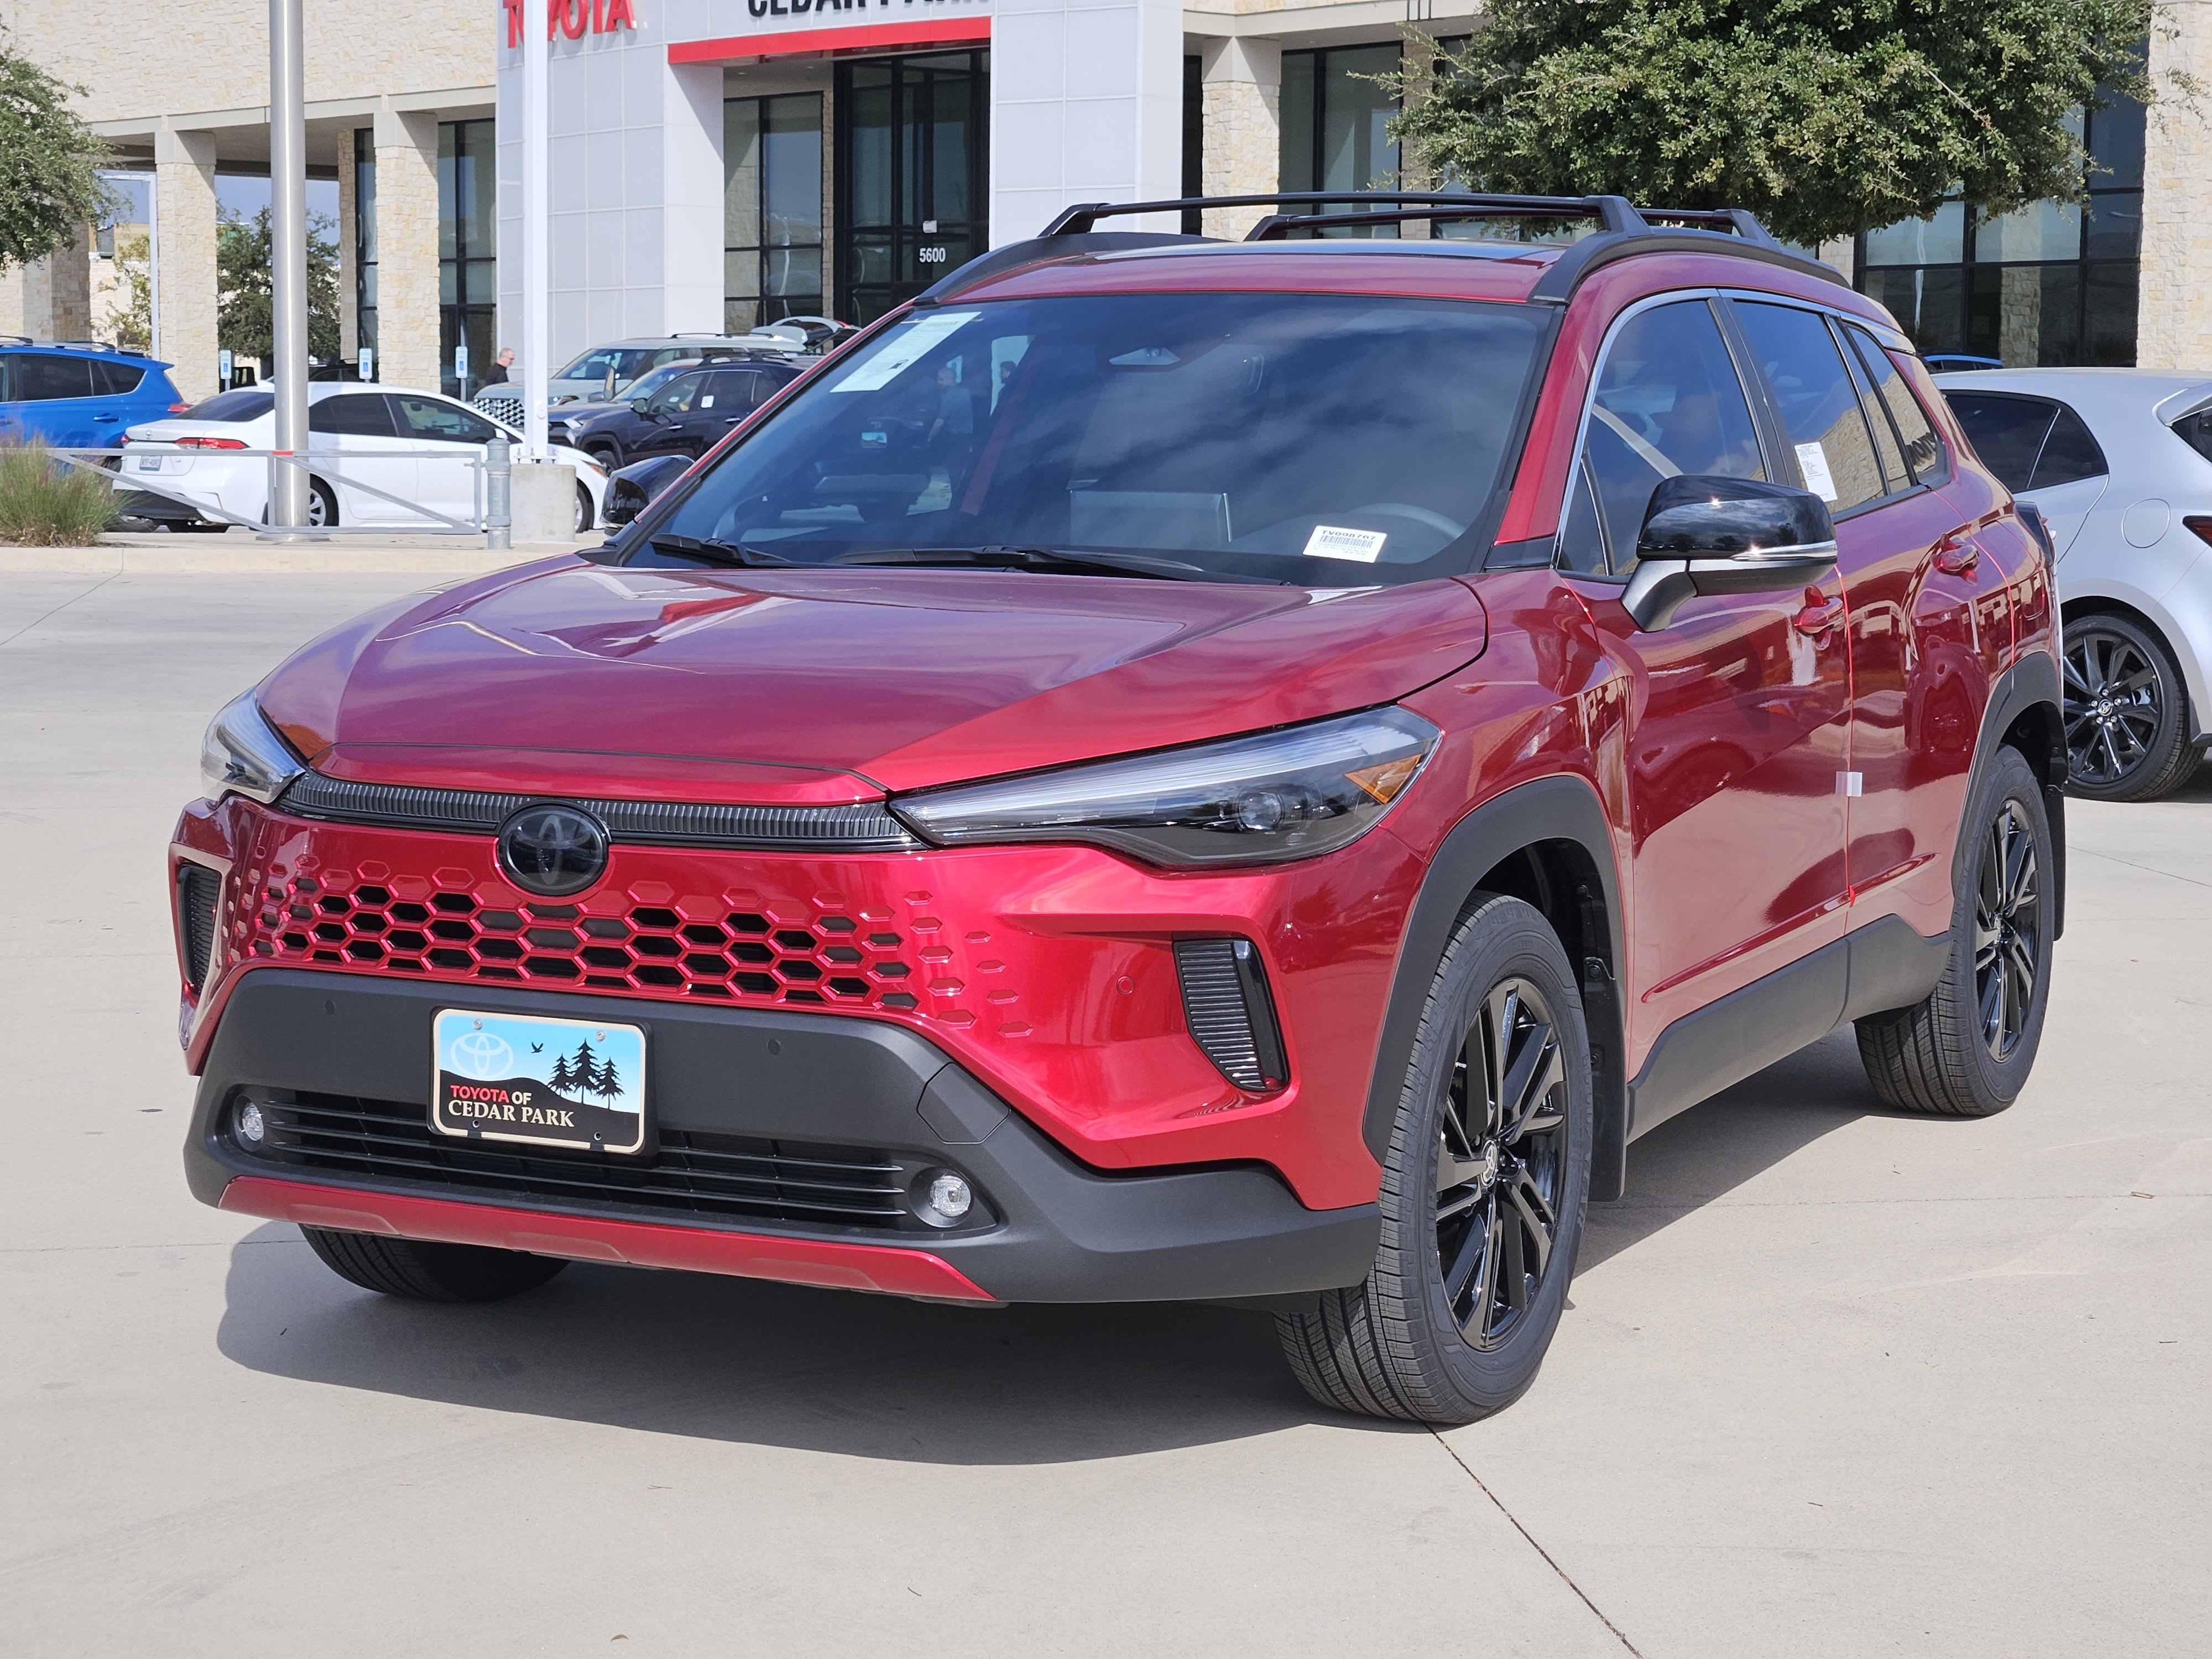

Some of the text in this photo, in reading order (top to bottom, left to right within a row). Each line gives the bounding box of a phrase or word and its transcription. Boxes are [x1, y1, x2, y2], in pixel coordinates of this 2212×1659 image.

[919, 247, 946, 263] 5600
[1322, 530, 1376, 540] TV098767
[450, 1085, 531, 1105] TOYOTA OF
[448, 1100, 574, 1127] CEDAR PARK
